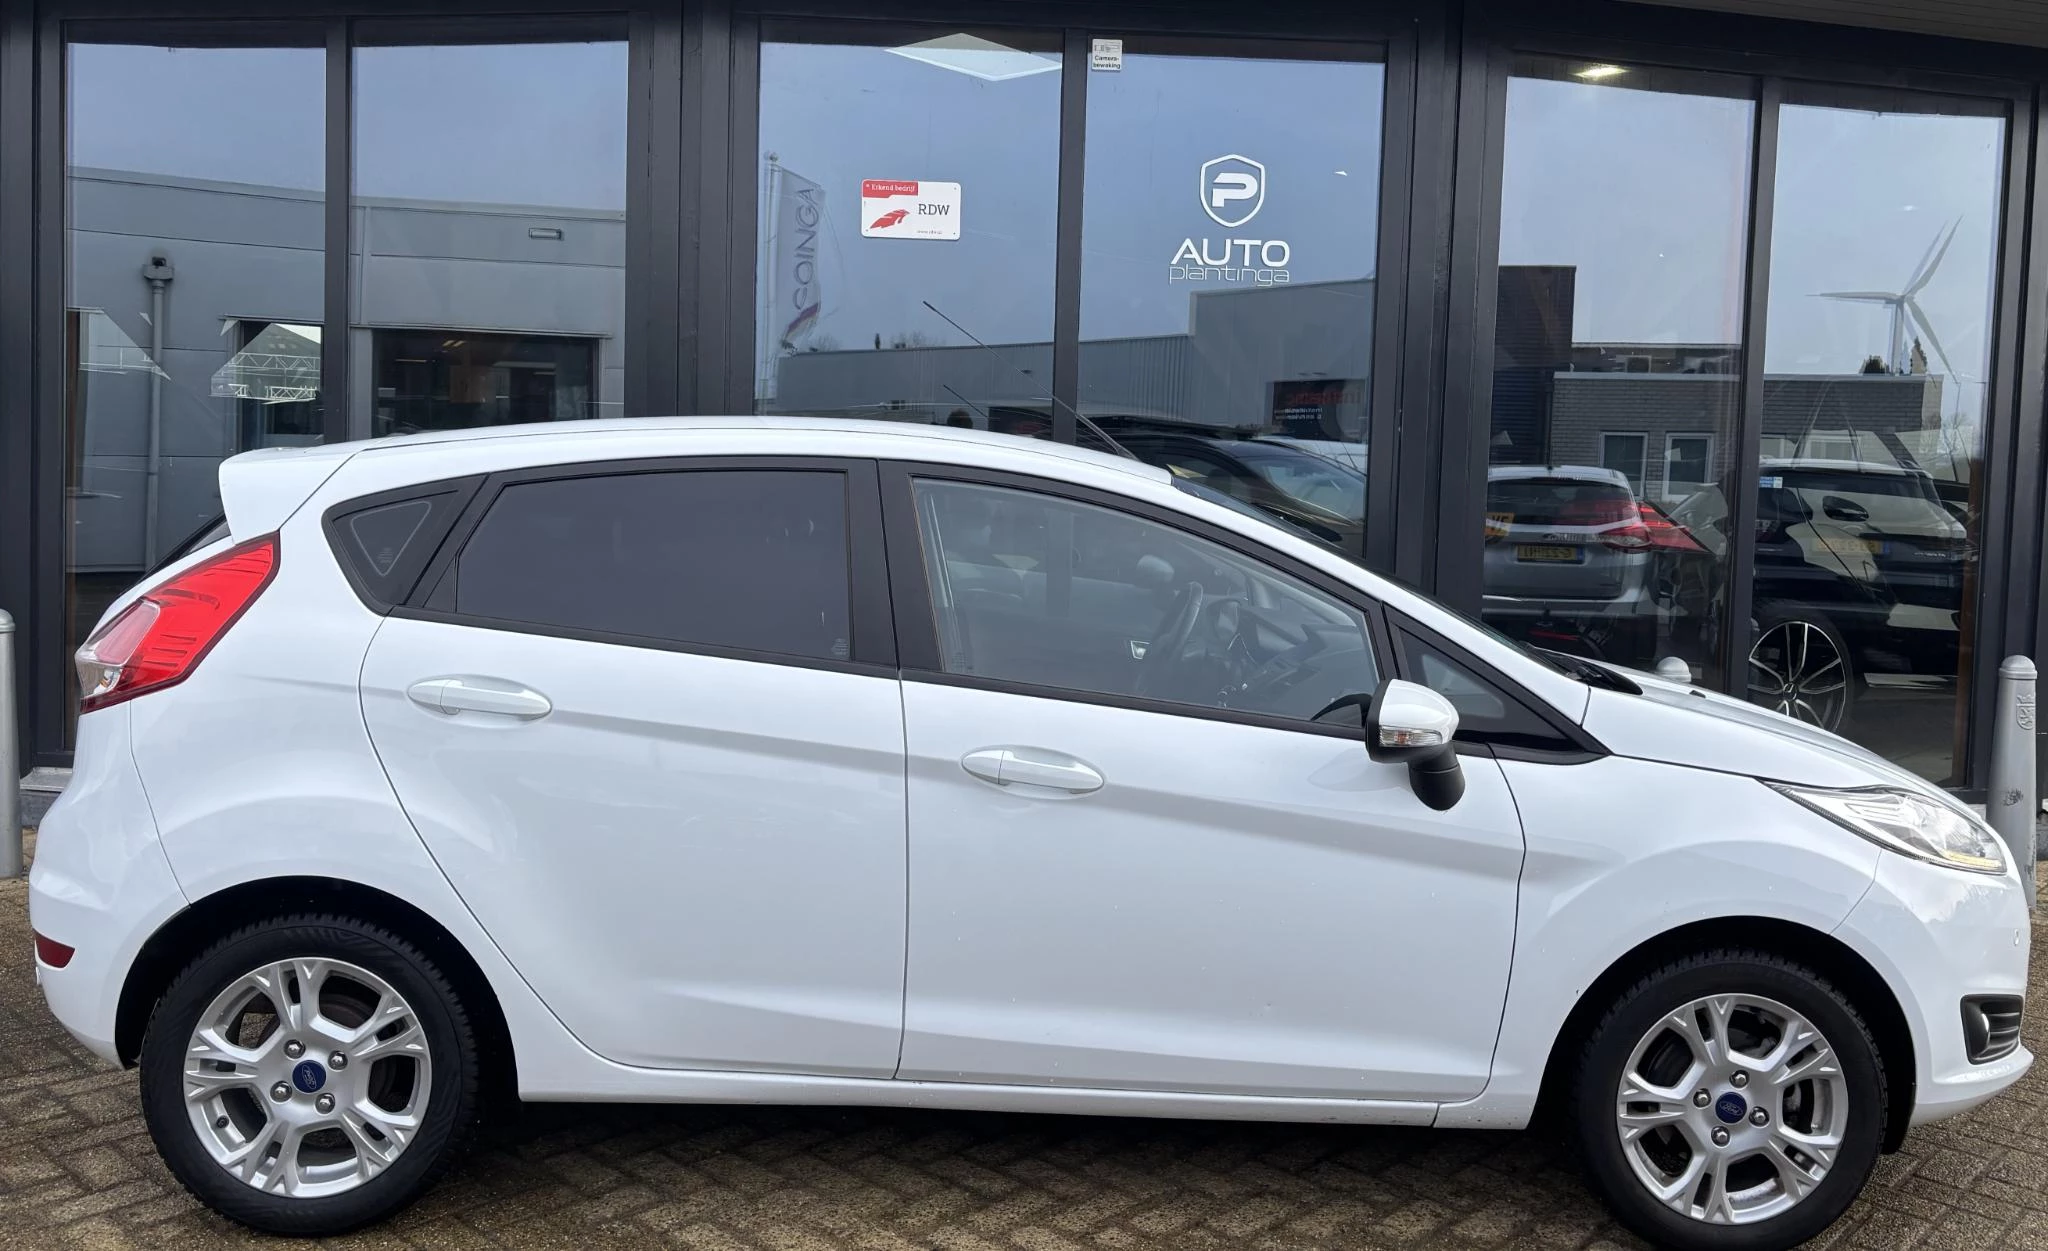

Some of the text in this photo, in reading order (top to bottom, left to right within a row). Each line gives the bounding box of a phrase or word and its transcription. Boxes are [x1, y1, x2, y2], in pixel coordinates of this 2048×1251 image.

[871, 183, 894, 191] Erkend
[1212, 172, 1258, 208] P
[918, 203, 950, 216] RDW
[1170, 237, 1290, 268] AUTO
[1169, 263, 1290, 287] plantinga
